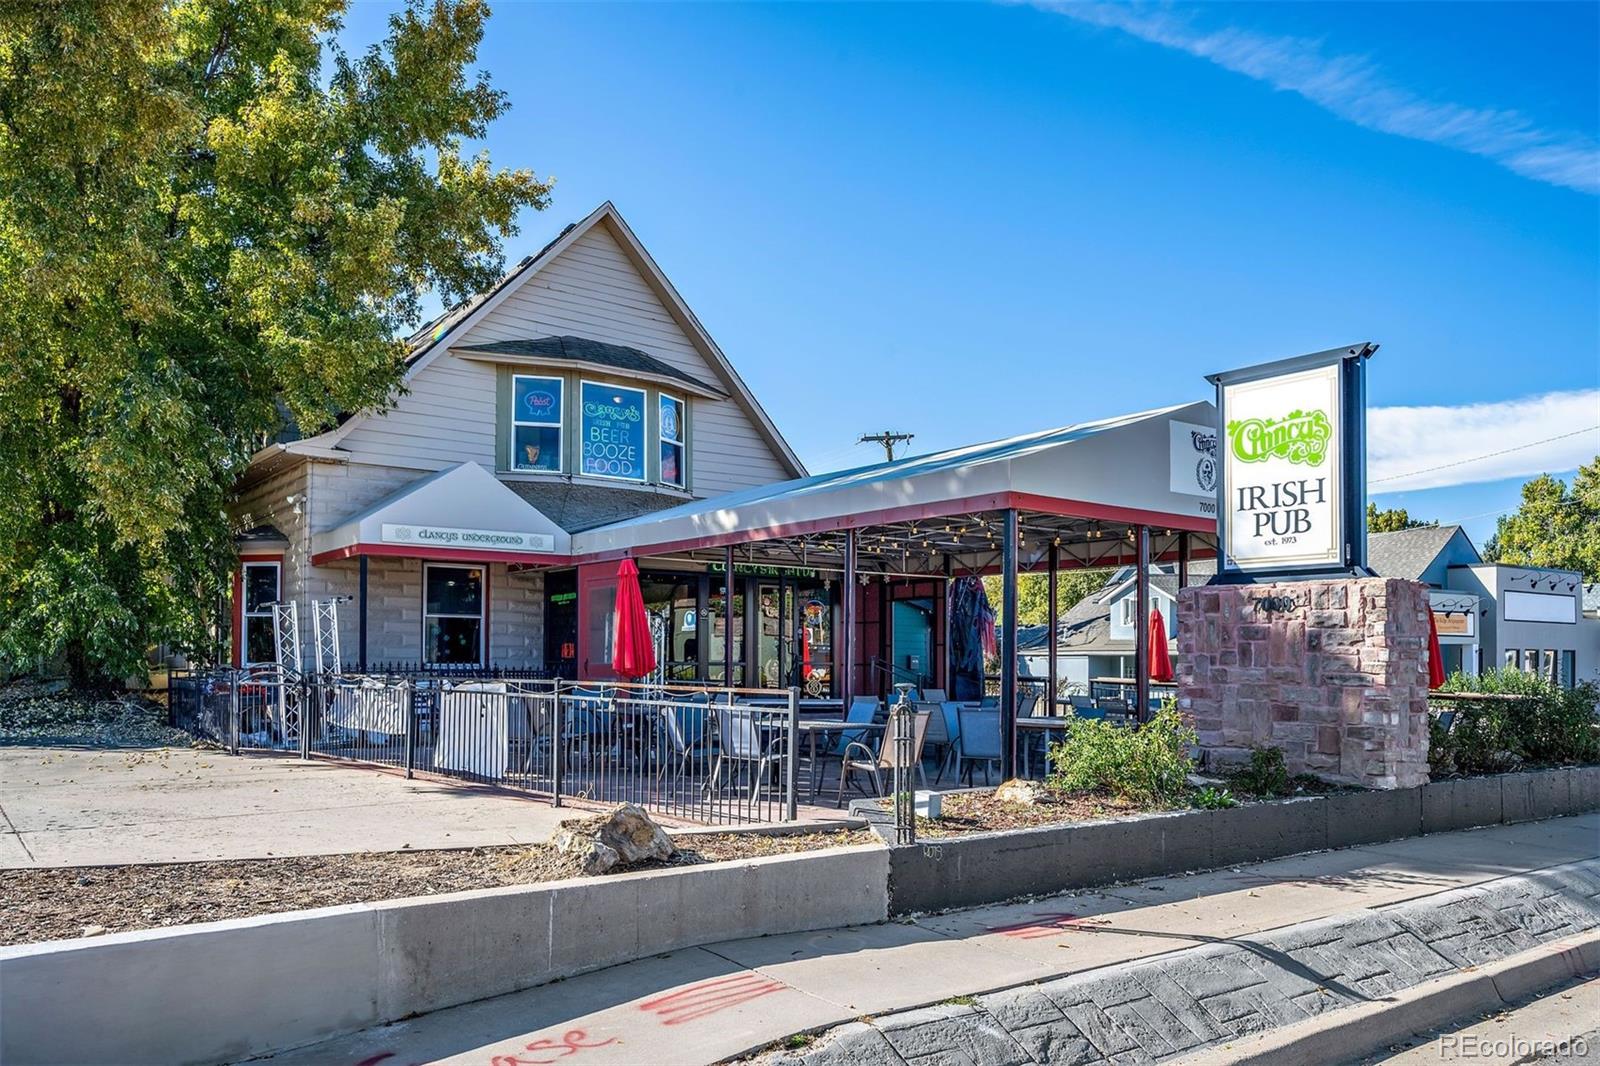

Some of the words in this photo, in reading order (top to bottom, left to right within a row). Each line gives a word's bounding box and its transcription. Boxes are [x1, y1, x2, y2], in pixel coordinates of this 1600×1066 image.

[590, 426, 629, 444] BEER
[584, 441, 636, 461] BOOZE
[586, 457, 632, 476] FOOD
[1237, 477, 1326, 512] IRISH
[1199, 502, 1216, 514] 7000
[1253, 508, 1312, 537] PUB
[462, 533, 523, 546] UNDERGROUND
[1264, 538, 1278, 546] est.
[1281, 536, 1297, 545] 1973
